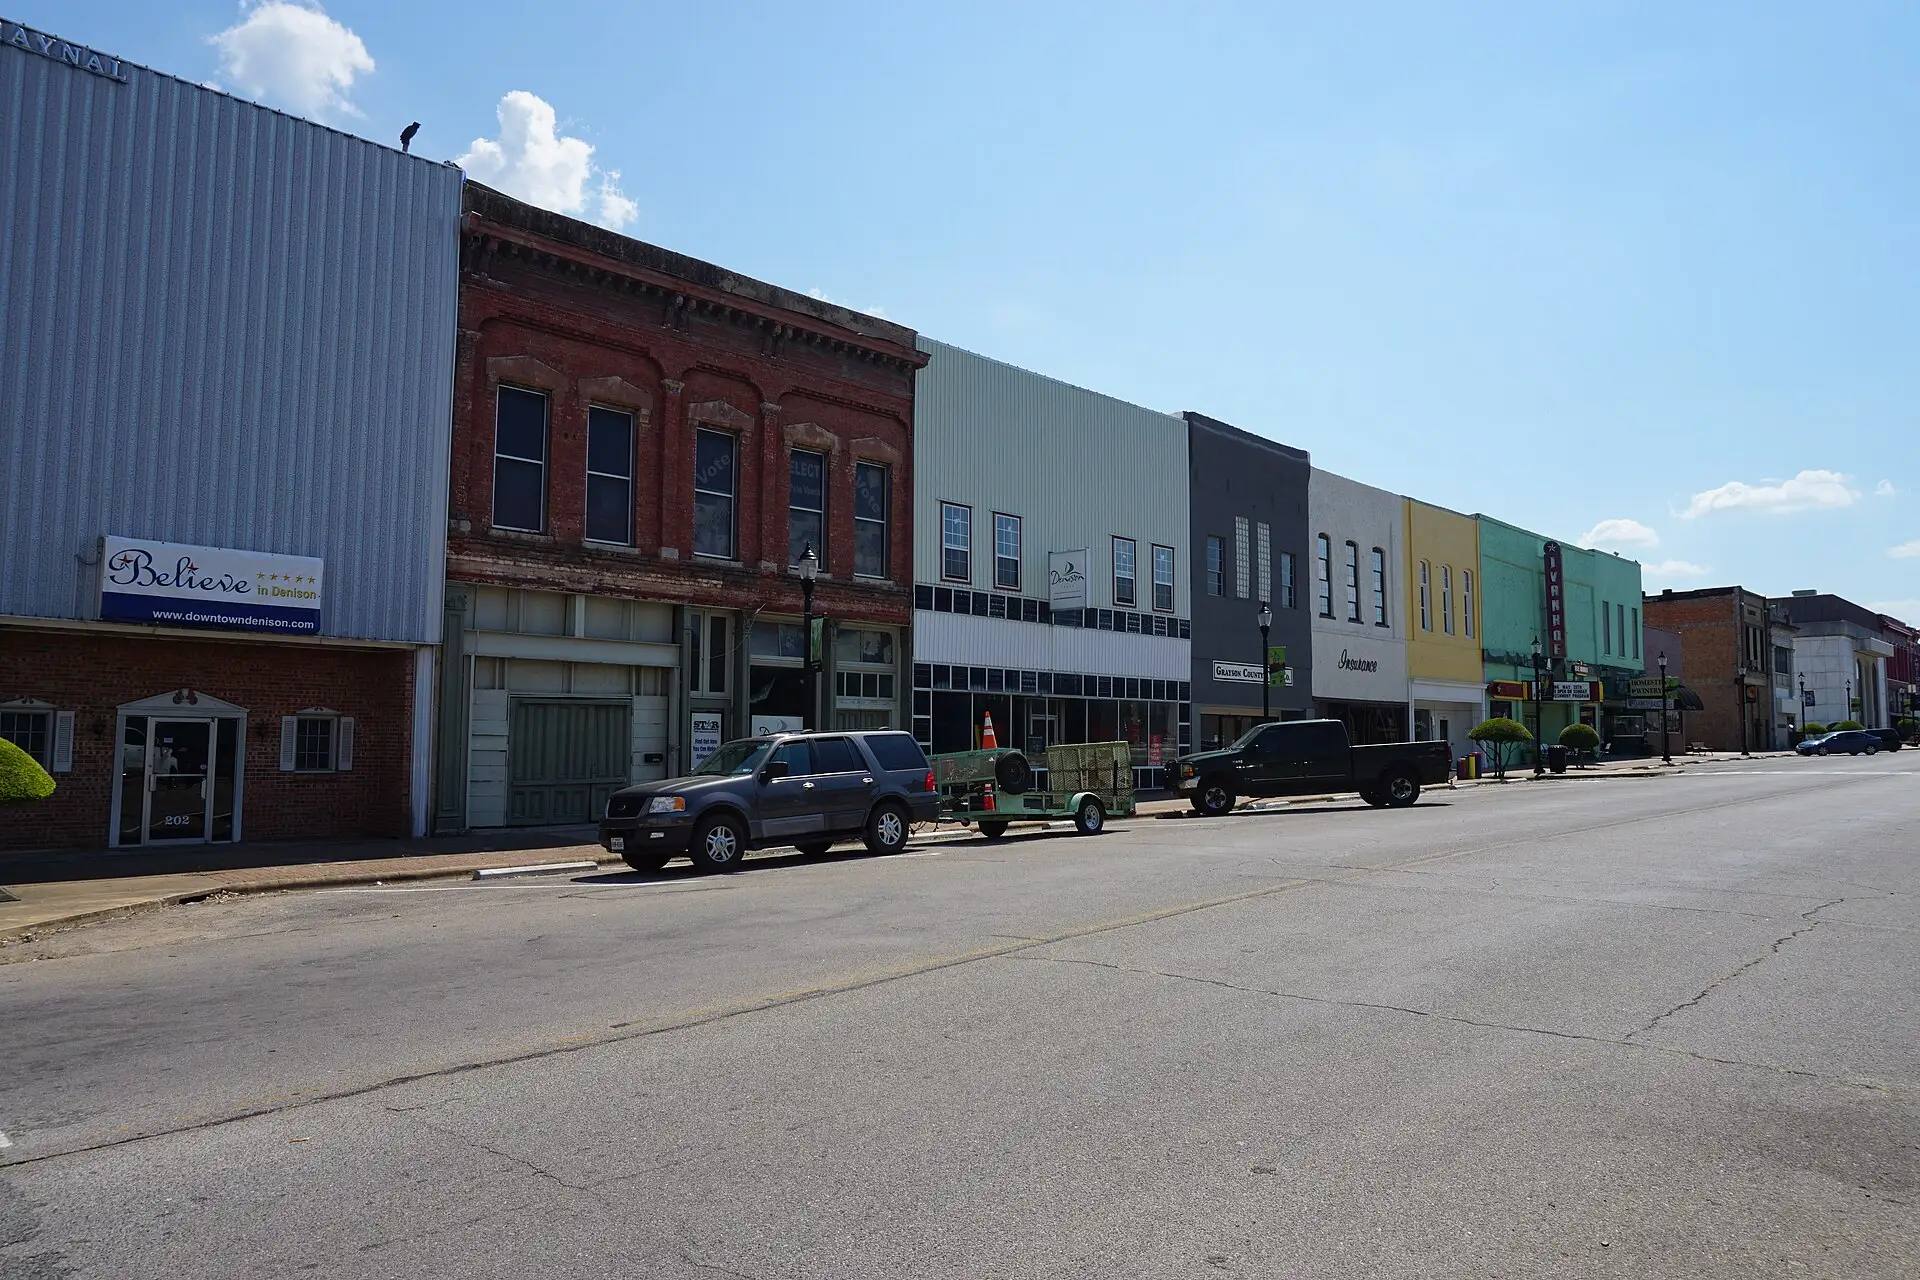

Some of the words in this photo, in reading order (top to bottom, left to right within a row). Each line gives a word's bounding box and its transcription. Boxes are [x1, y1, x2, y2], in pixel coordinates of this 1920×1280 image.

[0, 21, 127, 81] AYNAL
[696, 454, 730, 484] Vote
[790, 460, 820, 478] ELECT
[108, 549, 252, 595] Believe
[1050, 570, 1085, 586] Denison
[256, 585, 269, 597] in
[271, 586, 317, 600] Denison
[1549, 556, 1562, 656] IVANHOE
[152, 609, 315, 630] www.downtowndenison.com
[1337, 648, 1378, 673] Insurance
[165, 815, 190, 826] 202
